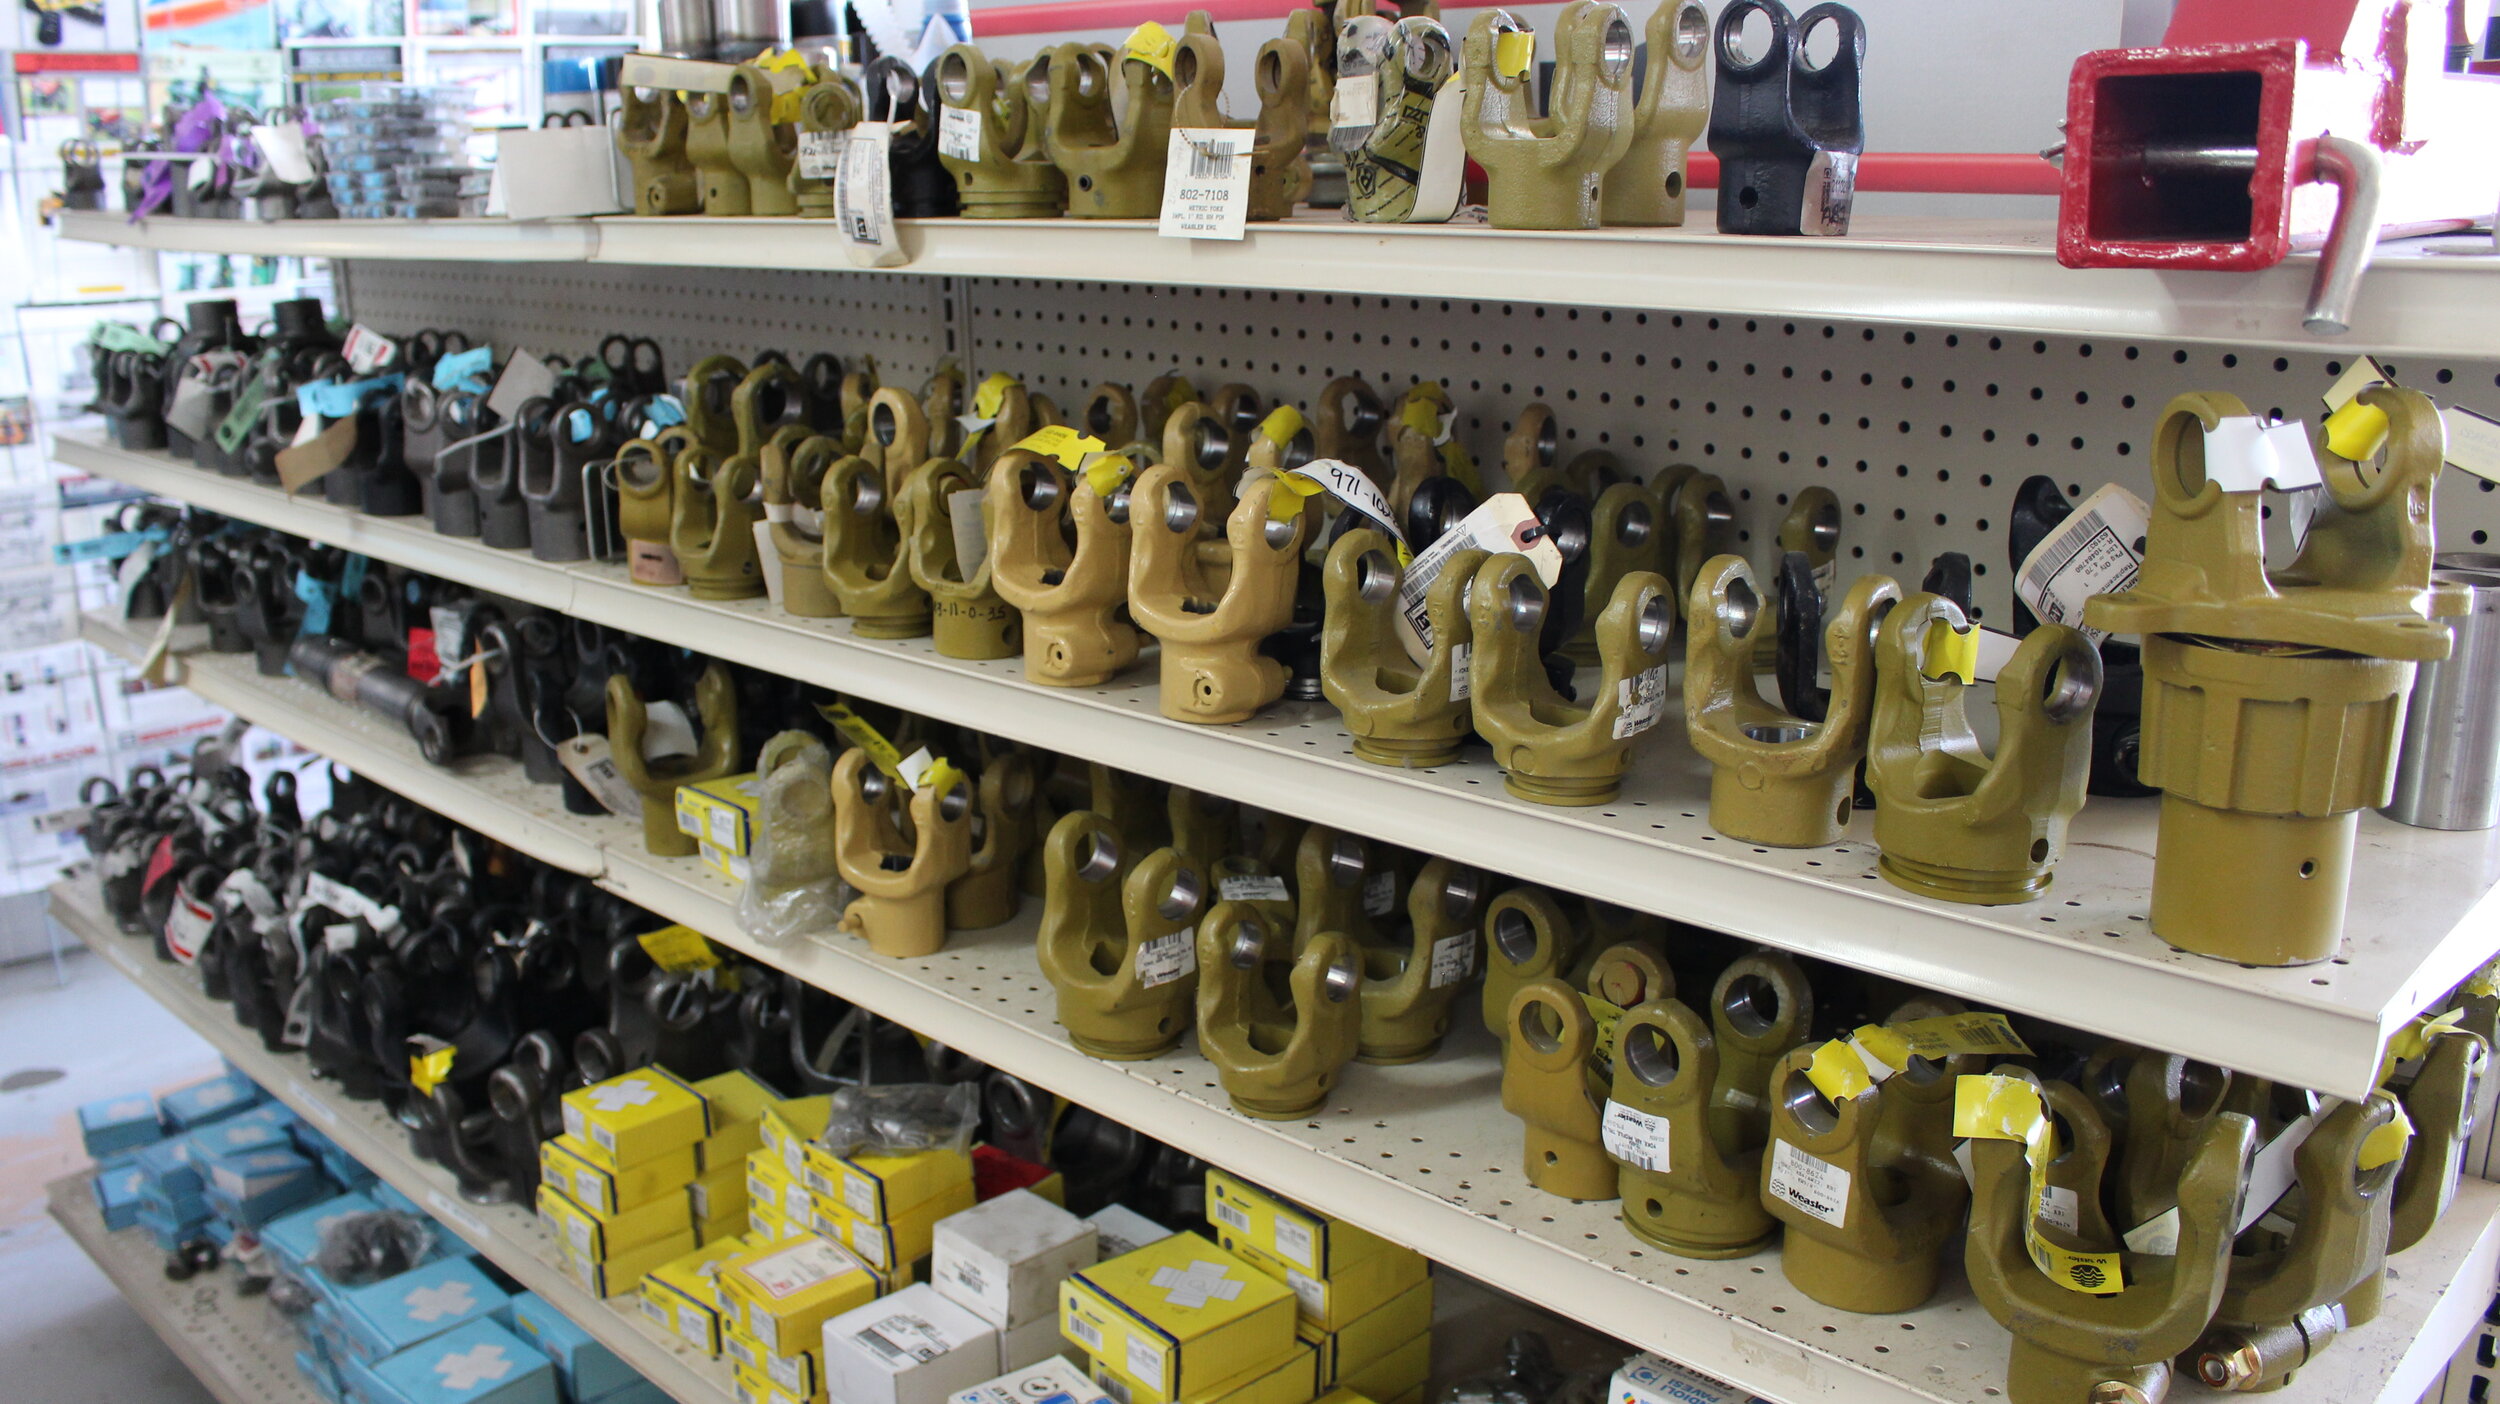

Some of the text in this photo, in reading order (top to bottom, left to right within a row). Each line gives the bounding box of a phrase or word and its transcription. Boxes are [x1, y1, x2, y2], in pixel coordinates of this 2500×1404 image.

[1180, 189, 1229, 200] 802-7108
[2106, 544, 2118, 555] Lbs
[2111, 550, 2123, 561] Pkg
[2085, 562, 2098, 574] 4.70
[2100, 561, 2111, 571] Qty
[1790, 1160, 1824, 1180] 800-8624
[1789, 1187, 1830, 1213] Weasler
[1667, 1378, 1720, 1402] PAVESI
